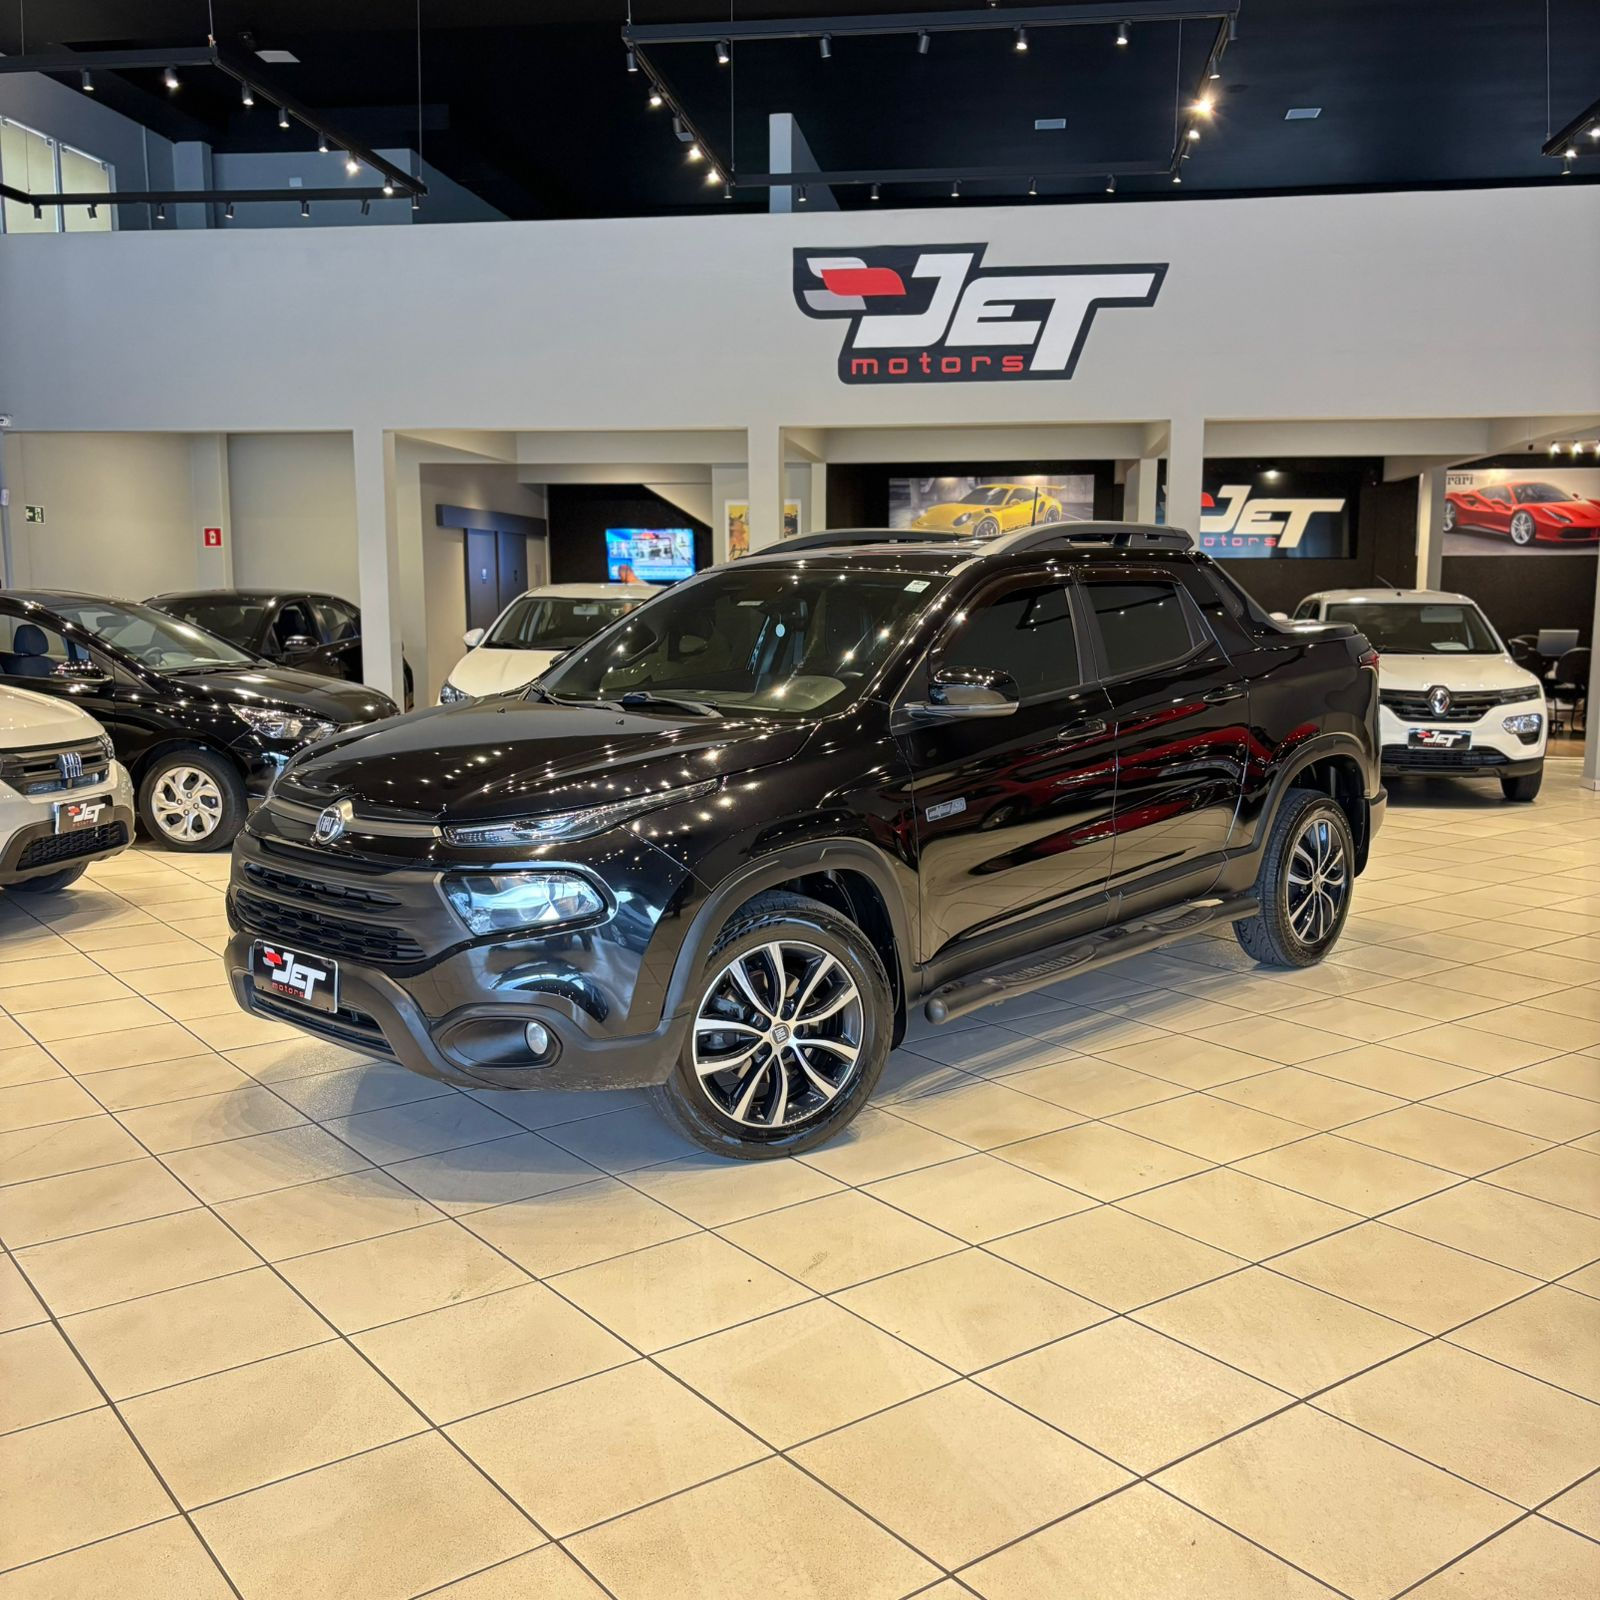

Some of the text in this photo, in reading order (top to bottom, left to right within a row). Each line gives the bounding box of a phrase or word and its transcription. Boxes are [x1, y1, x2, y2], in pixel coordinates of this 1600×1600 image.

[852, 253, 1155, 371] JET
[851, 352, 1024, 375] motors
[1447, 476, 1473, 485] rari
[1200, 485, 1346, 548] JET
[1203, 535, 1277, 547] otors
[1423, 730, 1463, 747] JET
[73, 803, 106, 823] JET
[320, 815, 336, 832] FIAT
[272, 952, 327, 1000] JET
[271, 982, 305, 998] motors
